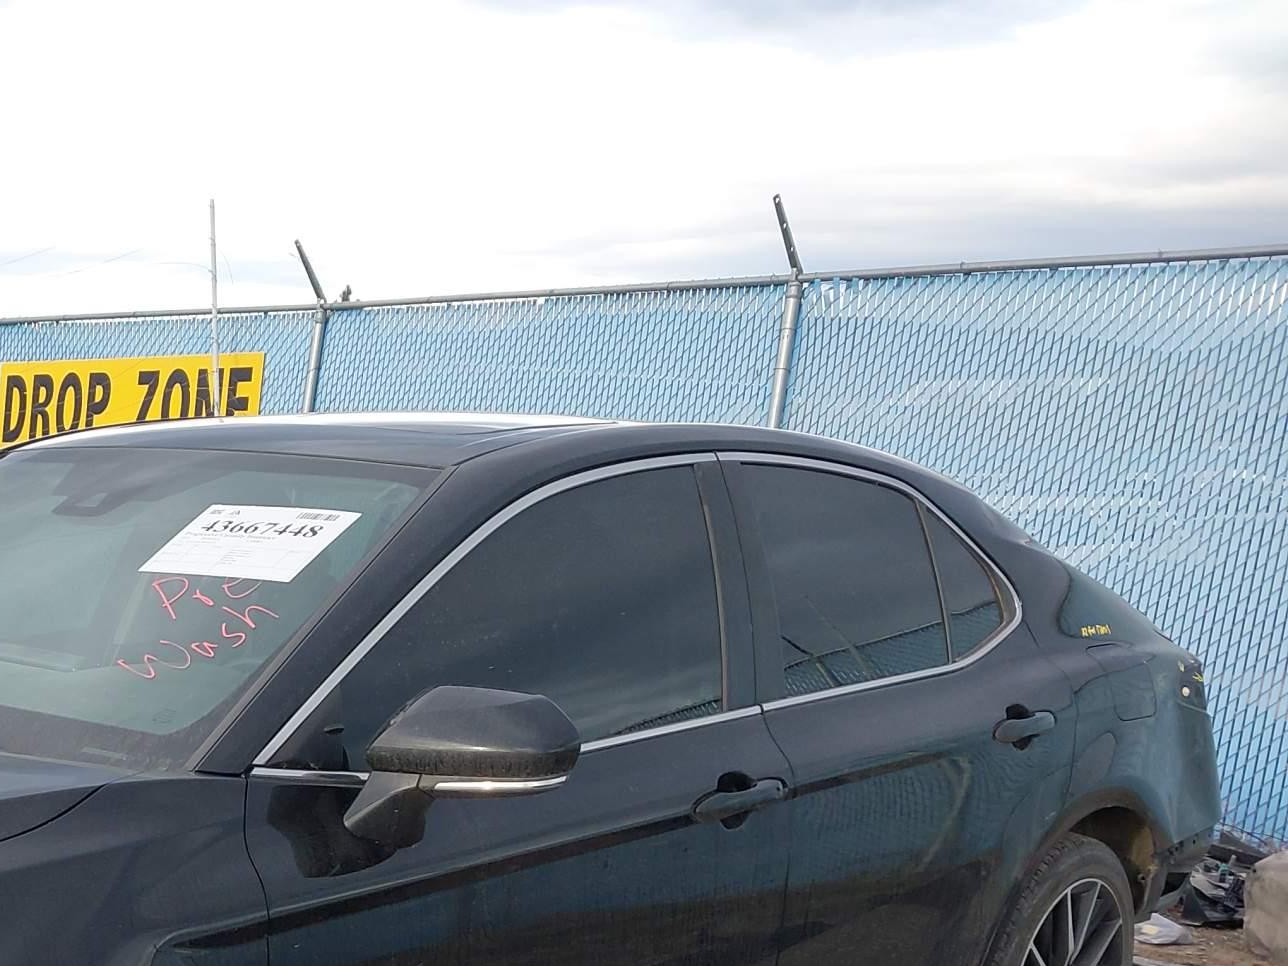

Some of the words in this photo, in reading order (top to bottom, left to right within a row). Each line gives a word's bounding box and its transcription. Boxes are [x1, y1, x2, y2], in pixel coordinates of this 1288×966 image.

[2, 371, 112, 443] DROP
[136, 366, 254, 422] ZONE
[200, 519, 325, 539] 43667448
[117, 605, 280, 679] Wash
